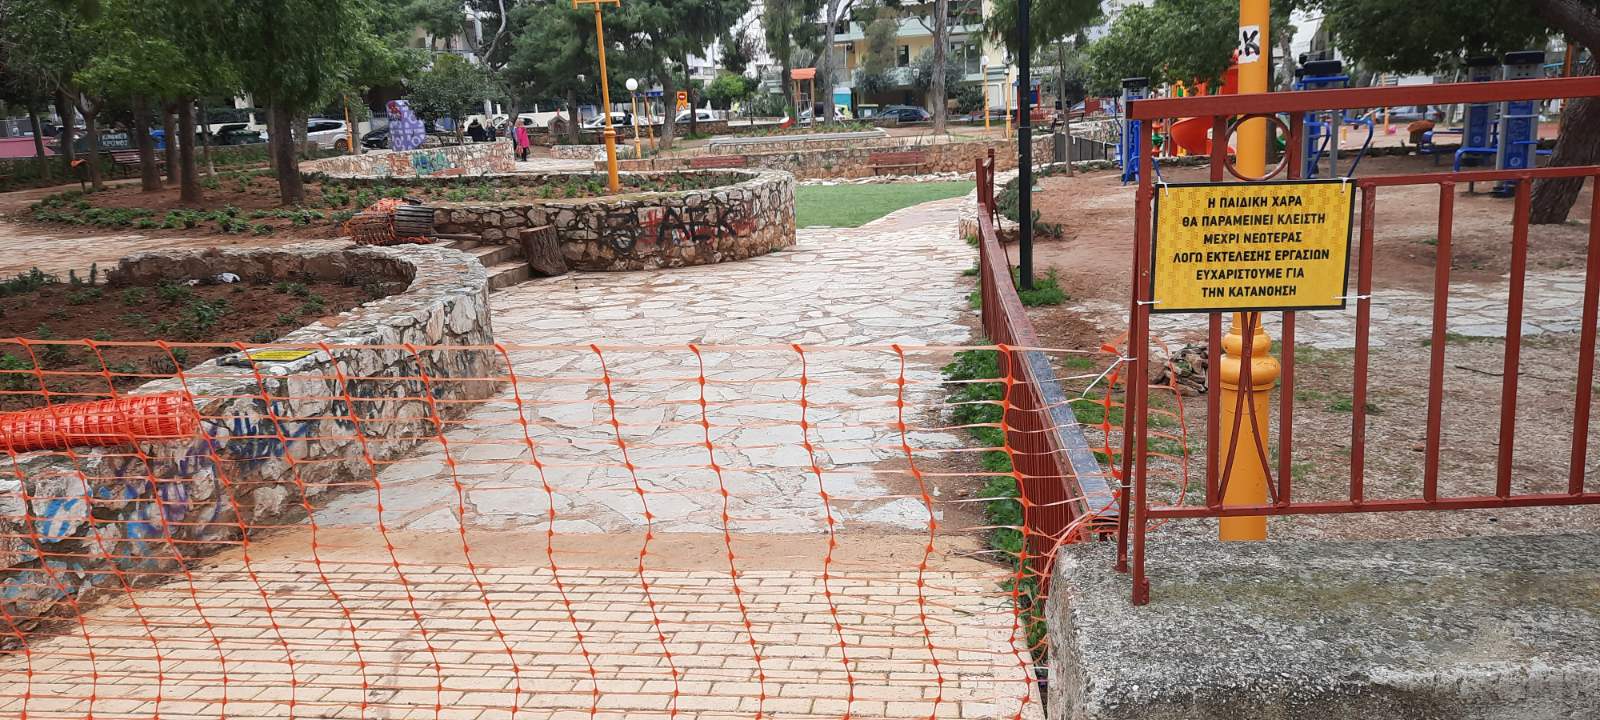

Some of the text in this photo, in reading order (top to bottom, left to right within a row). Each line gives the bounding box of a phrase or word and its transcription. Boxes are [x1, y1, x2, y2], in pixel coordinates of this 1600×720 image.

[1207, 195, 1302, 209] Η ΠΑΙΔΙΚΗ ΧΑΡΑ
[1182, 213, 1325, 227] ΘΑ ΠΑΡΑΜΕΙΝΕΙ ΚΛΕΙΣΤΗ
[1203, 232, 1302, 245] ΜΕΧΡΙ ΝΕΩΤΕΡΑΣ
[1173, 249, 1329, 263] ΛΟΓΩ ΕΚΤΕΛΕΣΗΣ ΕΡΓΑΣΙΩΝ
[1196, 267, 1304, 280] ΕΥΧΑΡΙΣΤΟΥΜΕ ΓΙΑ
[1202, 285, 1297, 298] ΤΗΝ ΚΑΤΑΝΟΗΣΗ
